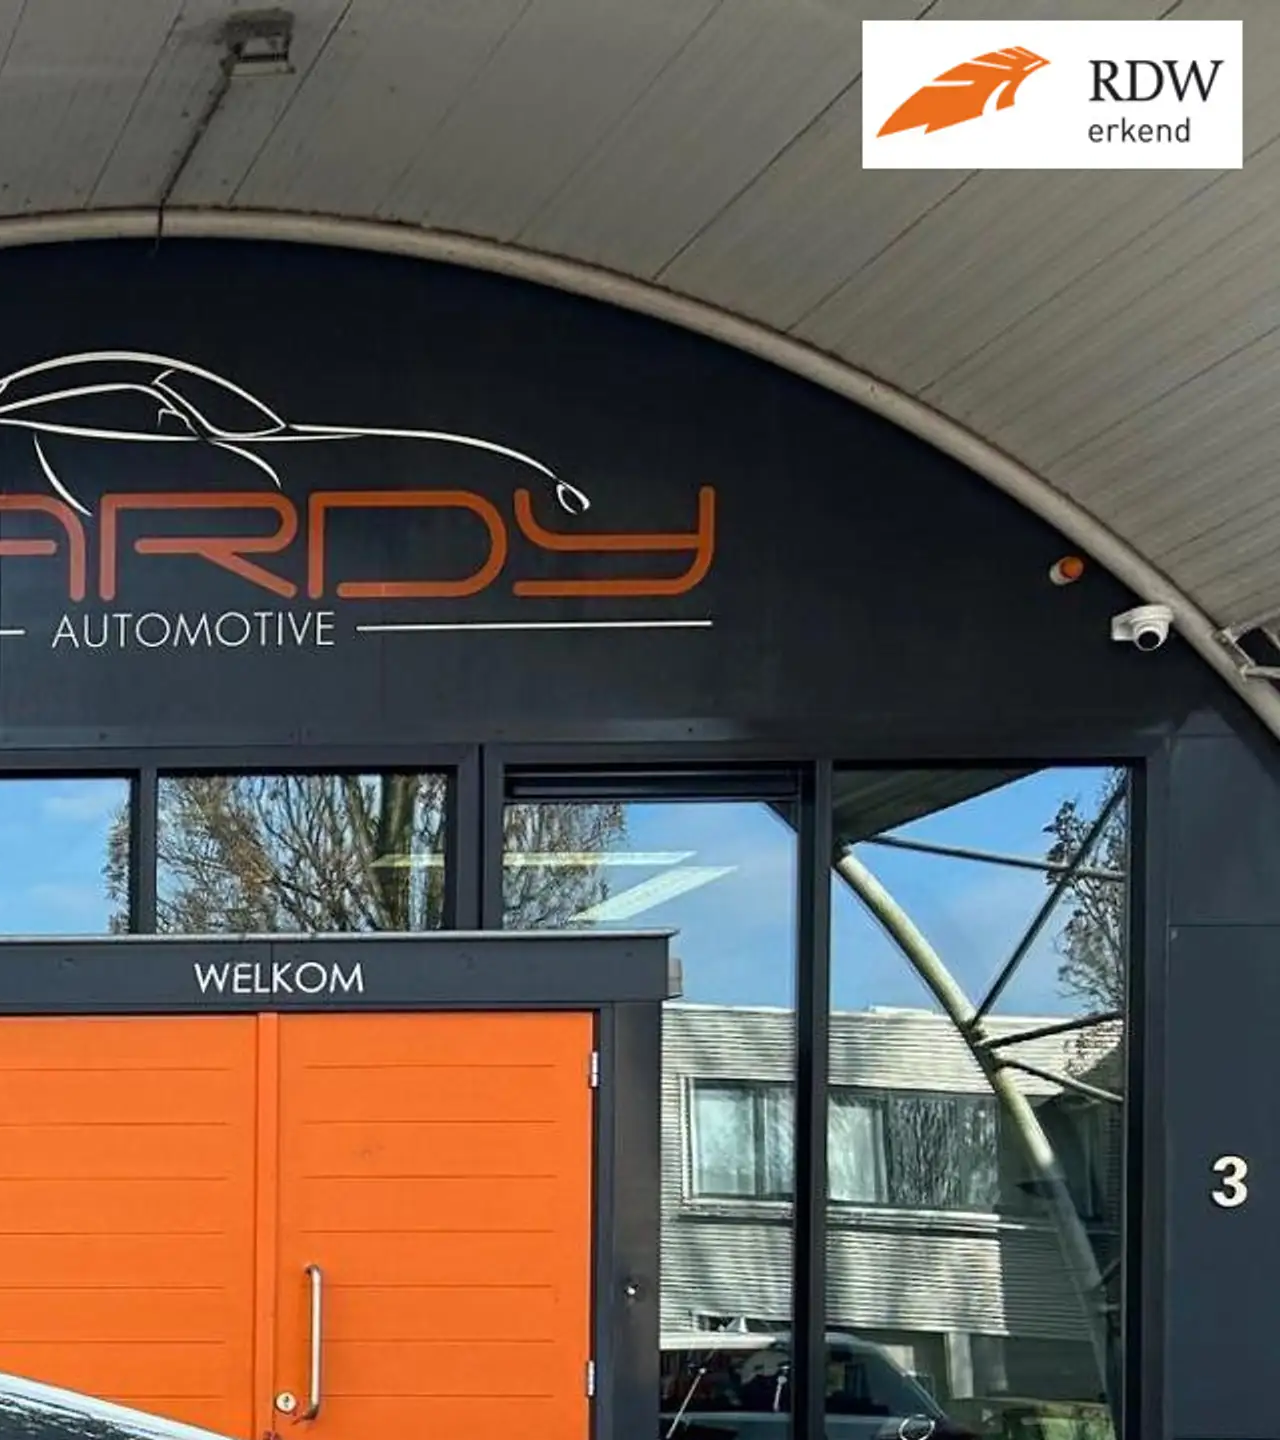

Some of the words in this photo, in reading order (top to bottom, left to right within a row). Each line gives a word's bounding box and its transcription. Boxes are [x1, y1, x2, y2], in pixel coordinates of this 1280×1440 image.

[51, 611, 335, 649] AUTOMOTIVE
[193, 961, 365, 994] WELKOM
[1211, 1155, 1249, 1208] 3
